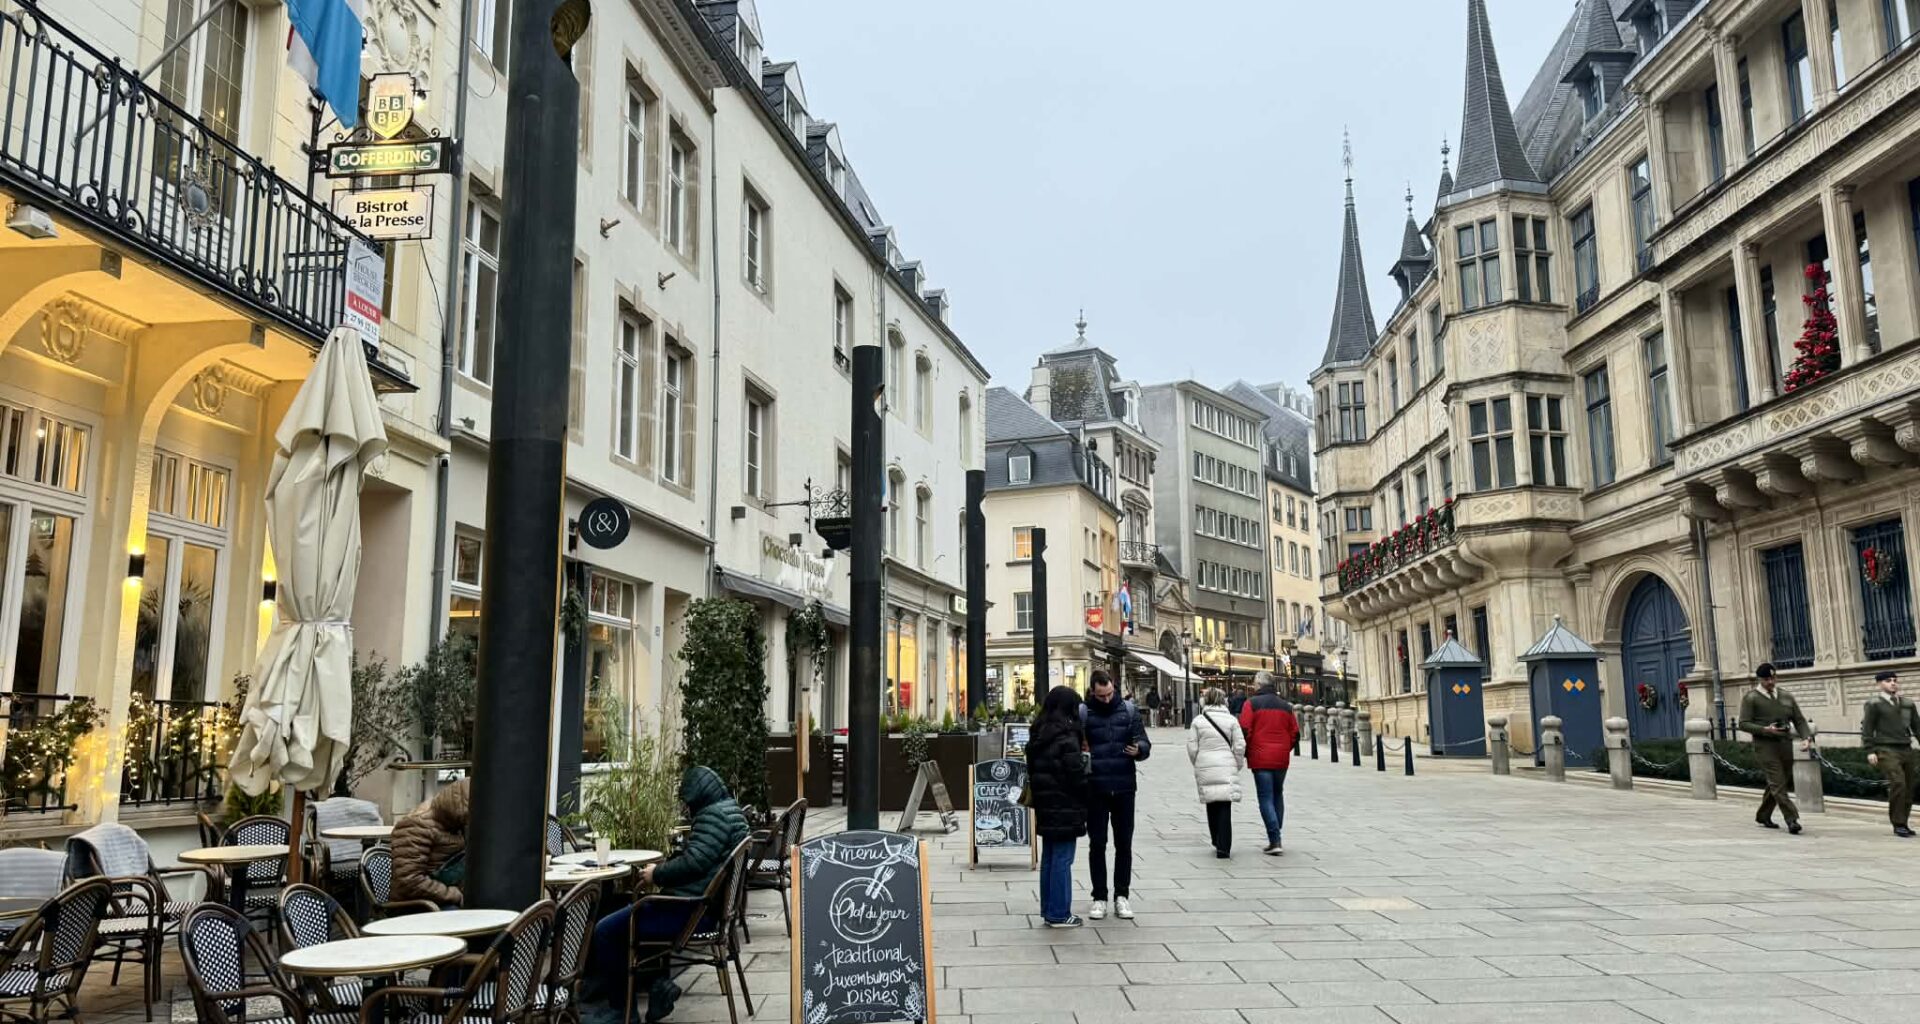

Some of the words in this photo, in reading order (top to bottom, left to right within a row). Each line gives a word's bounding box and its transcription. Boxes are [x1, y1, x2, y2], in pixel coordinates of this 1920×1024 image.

[339, 149, 431, 167] BOFFERDING
[356, 200, 408, 214] Bistrot
[360, 215, 372, 228] la
[375, 215, 424, 227] Presse
[358, 301, 377, 319] LOUER
[840, 847, 887, 863] menu
[832, 897, 867, 928] Plat
[865, 905, 877, 920] du
[842, 987, 899, 1006] Dishes
